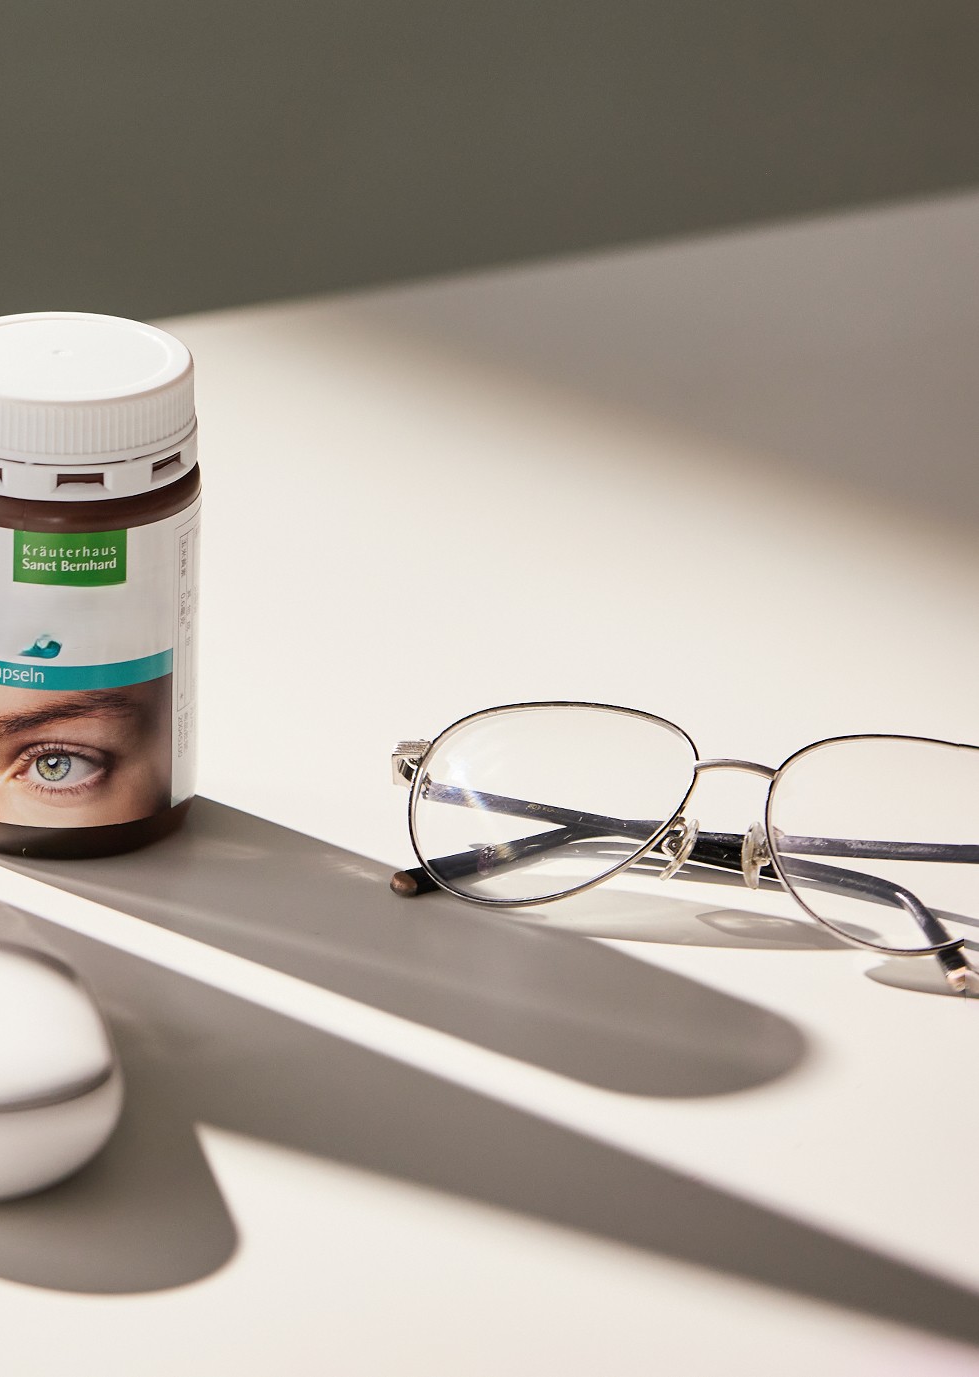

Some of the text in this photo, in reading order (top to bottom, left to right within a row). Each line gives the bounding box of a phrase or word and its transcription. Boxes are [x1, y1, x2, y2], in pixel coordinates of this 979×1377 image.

[22, 544, 117, 558] Kräuterhaus
[22, 557, 117, 572] Sanct Bernhard
